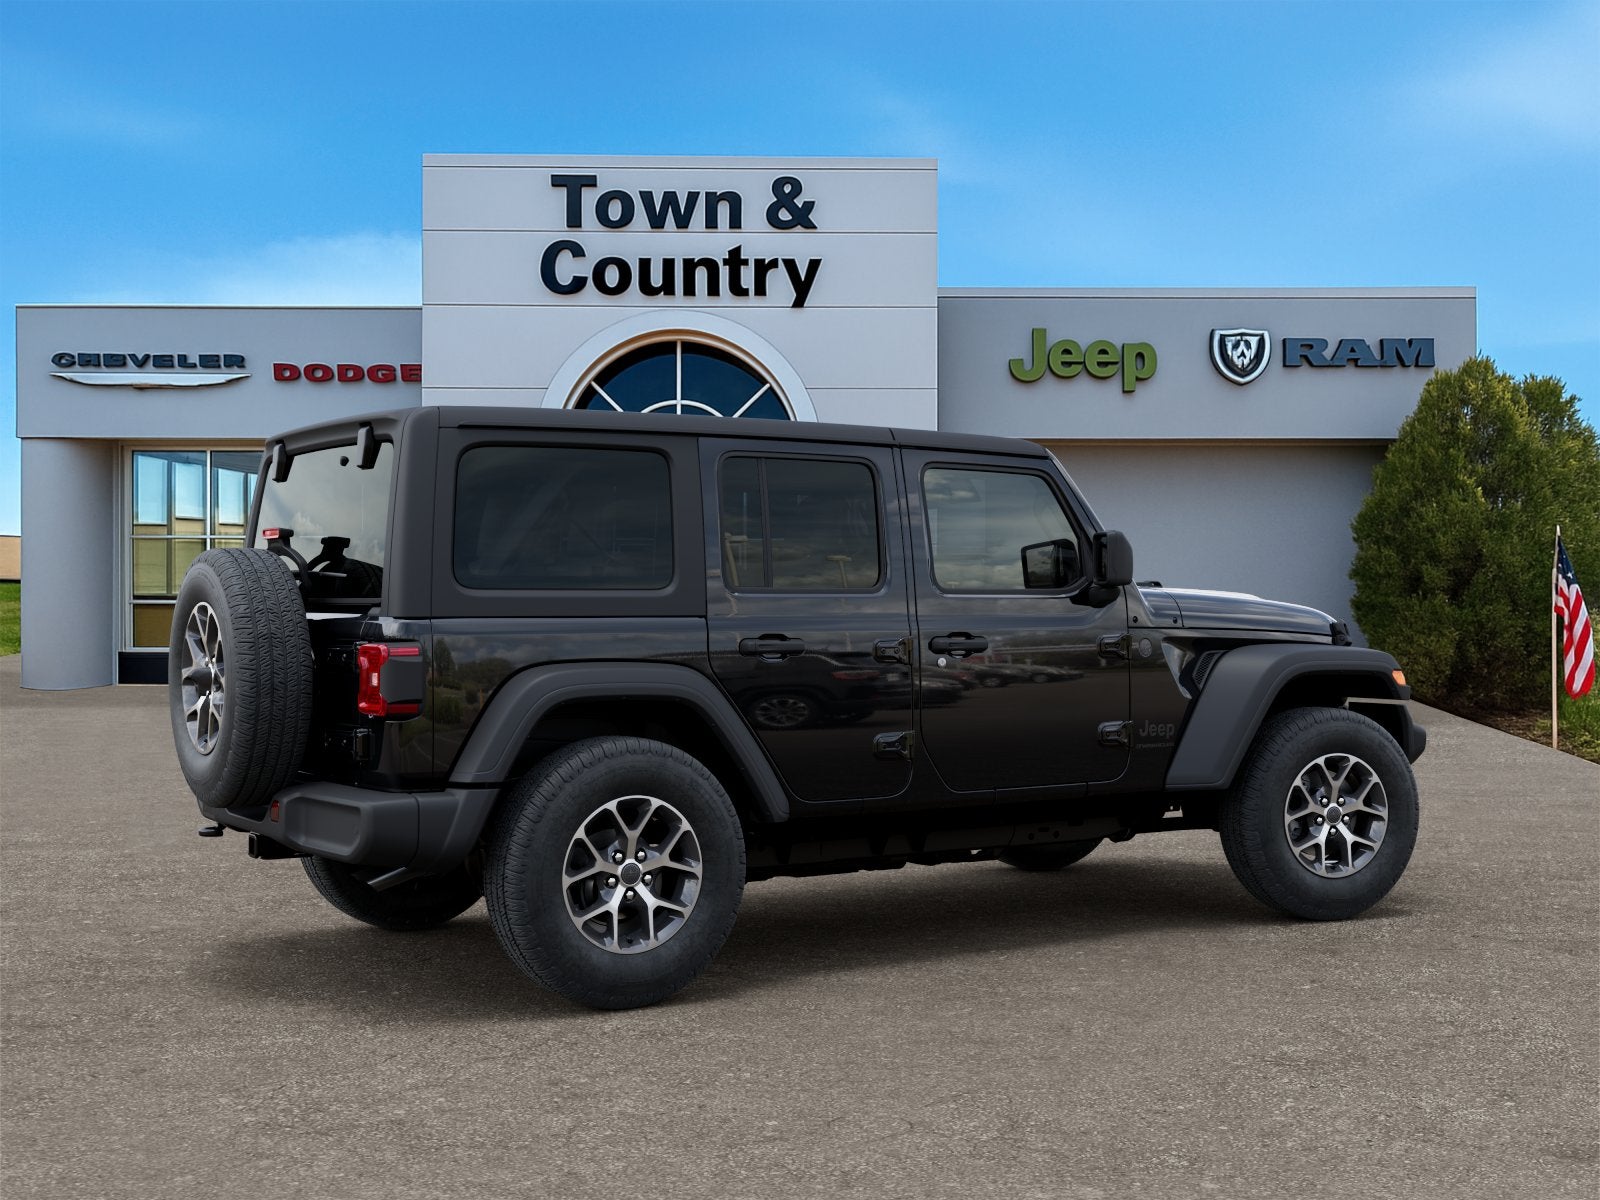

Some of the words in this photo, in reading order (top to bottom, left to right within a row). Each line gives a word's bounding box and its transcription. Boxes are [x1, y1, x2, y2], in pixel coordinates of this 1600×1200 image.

[550, 174, 743, 229] Town
[765, 176, 818, 230] &
[540, 239, 822, 308] Country
[272, 363, 422, 383] DODGE
[1008, 328, 1158, 393] Jeep
[1282, 337, 1435, 368] RAM
[1138, 720, 1175, 739] Jeep
